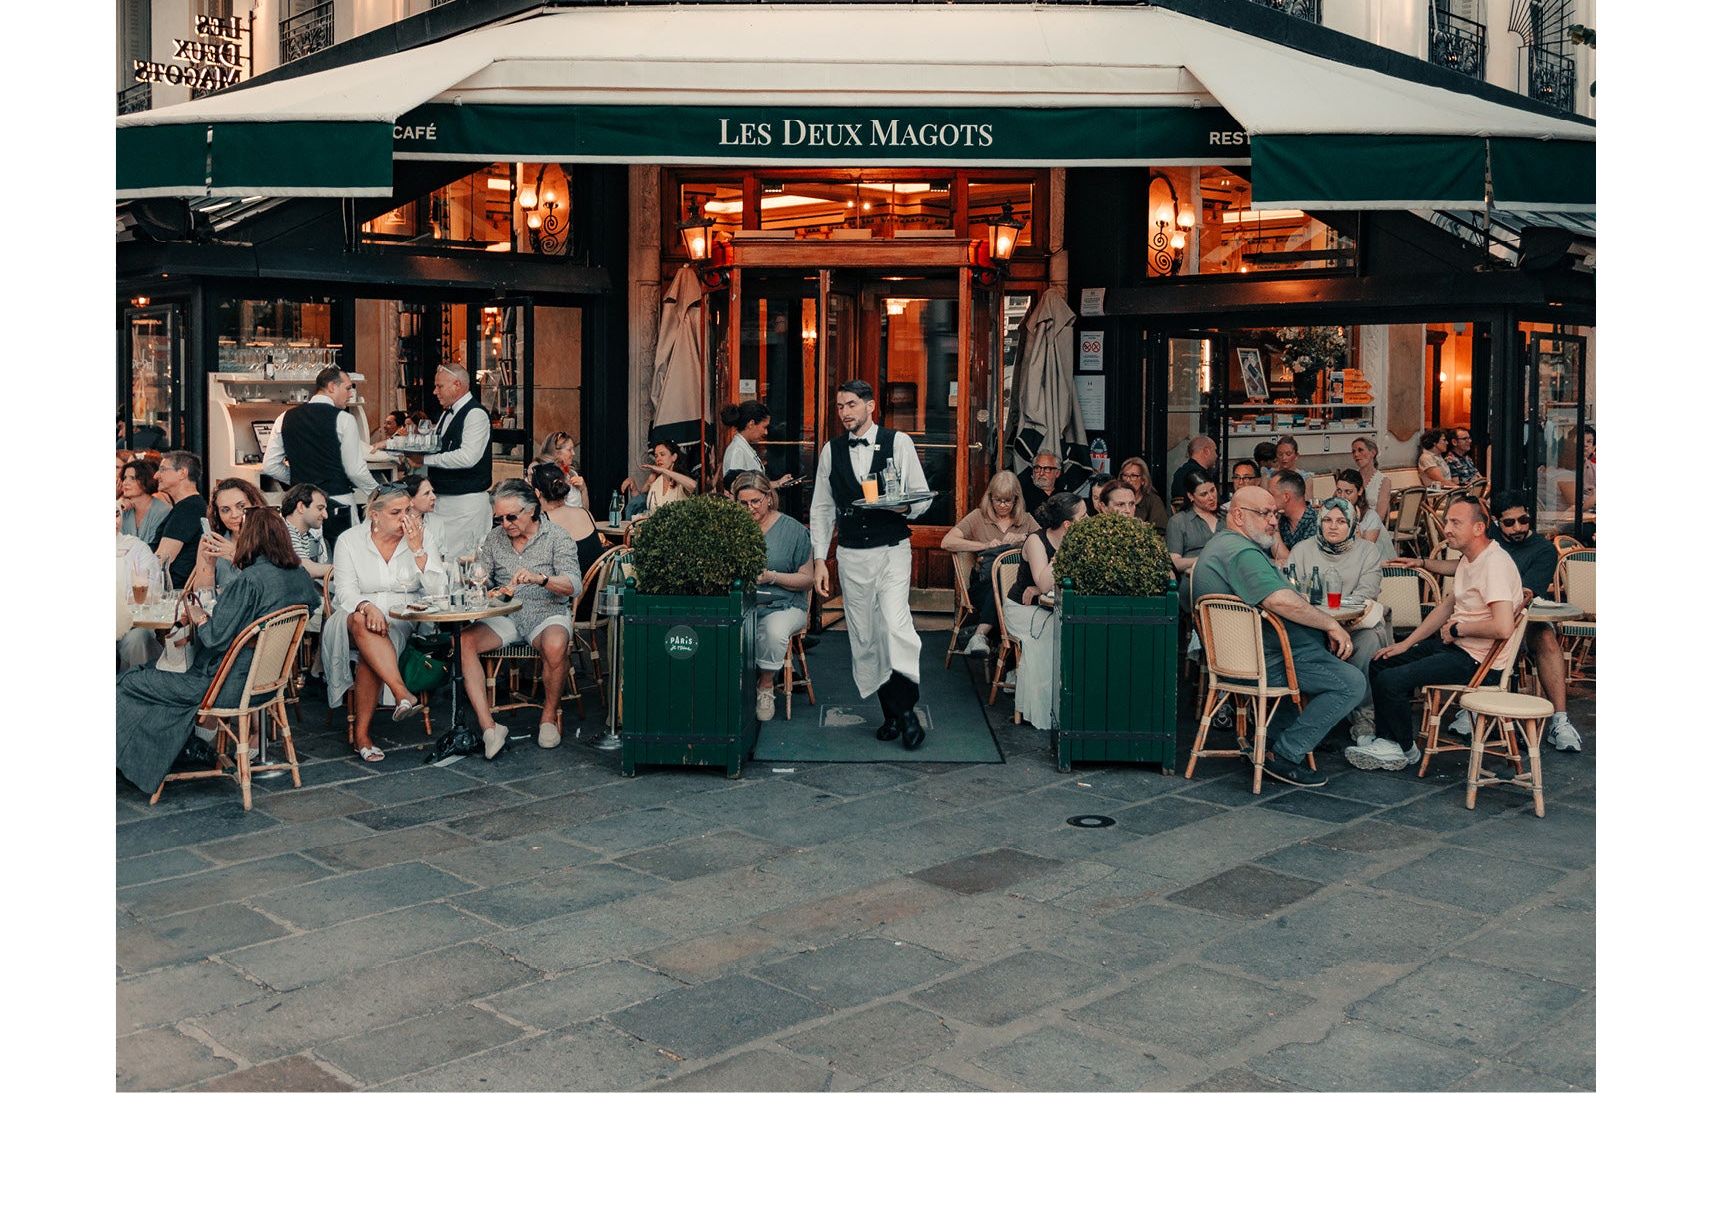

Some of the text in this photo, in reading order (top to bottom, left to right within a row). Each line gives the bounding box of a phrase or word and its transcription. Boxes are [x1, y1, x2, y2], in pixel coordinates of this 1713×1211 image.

[393, 122, 437, 140] CAFÉ
[719, 119, 993, 147] LES DEUX MAGOTS
